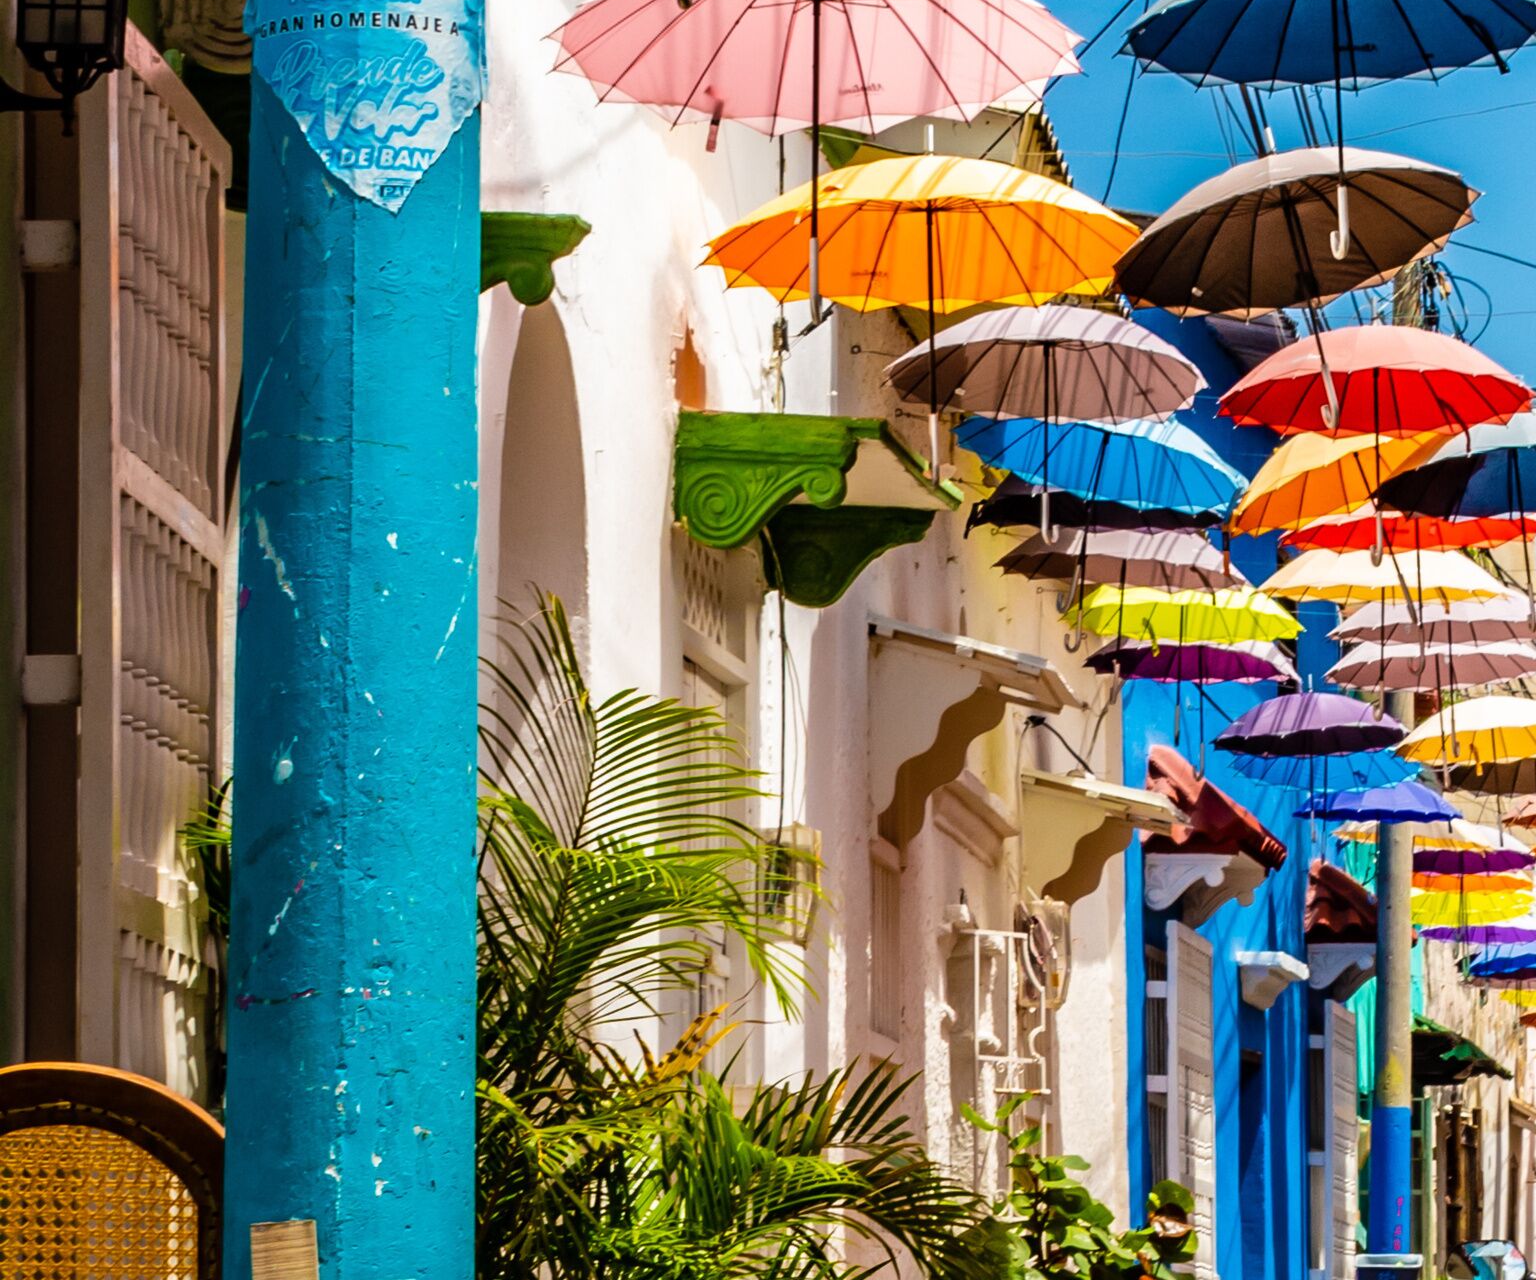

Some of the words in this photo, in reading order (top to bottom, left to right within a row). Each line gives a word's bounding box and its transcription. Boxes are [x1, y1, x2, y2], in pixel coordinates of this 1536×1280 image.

[260, 17, 304, 38] GRAN
[314, 12, 442, 33] HOMENAJE
[450, 22, 459, 36] A
[271, 38, 444, 101] Prende
[340, 148, 372, 167] DE
